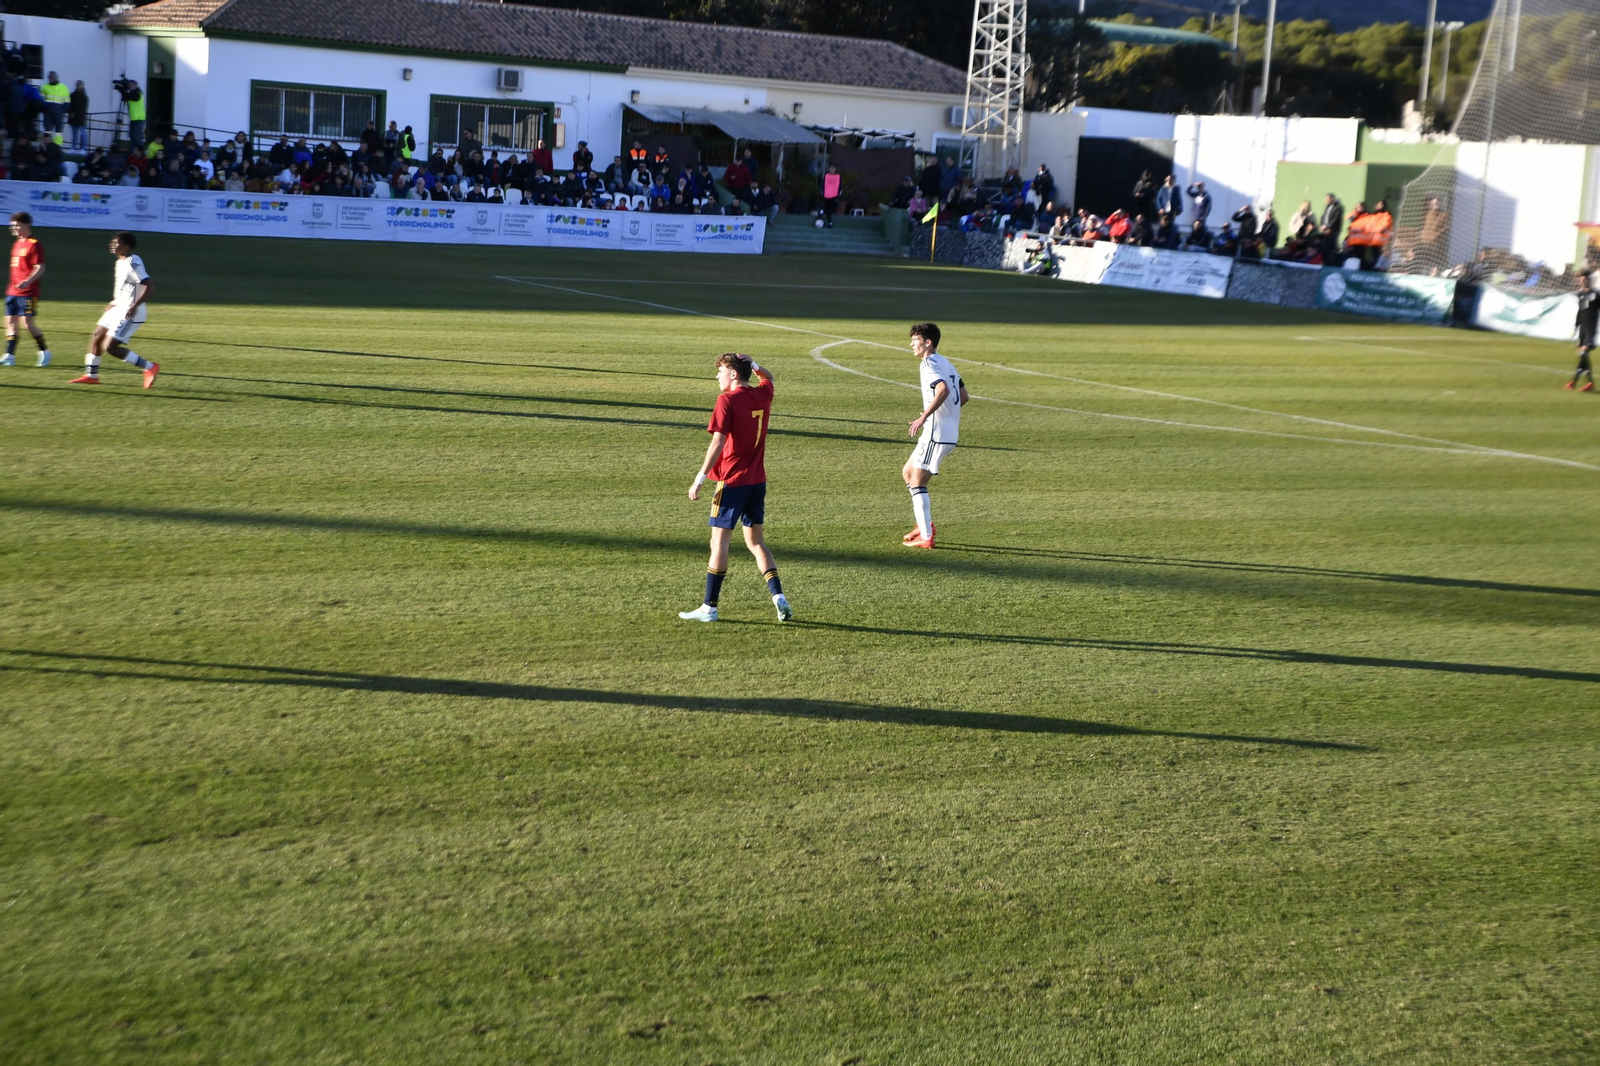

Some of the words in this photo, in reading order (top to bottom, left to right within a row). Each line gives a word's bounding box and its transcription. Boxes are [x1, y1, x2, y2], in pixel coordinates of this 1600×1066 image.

[30, 204, 110, 215] TORREMOLINOS
[216, 213, 288, 222] TORREMOLINOS
[386, 220, 455, 229] TORREMOLINOS
[546, 227, 609, 238] TORREMOLINOS
[621, 235, 647, 243] Torremolinos
[949, 375, 959, 405] 3
[752, 409, 764, 449] 7
[918, 443, 925, 456] 3
